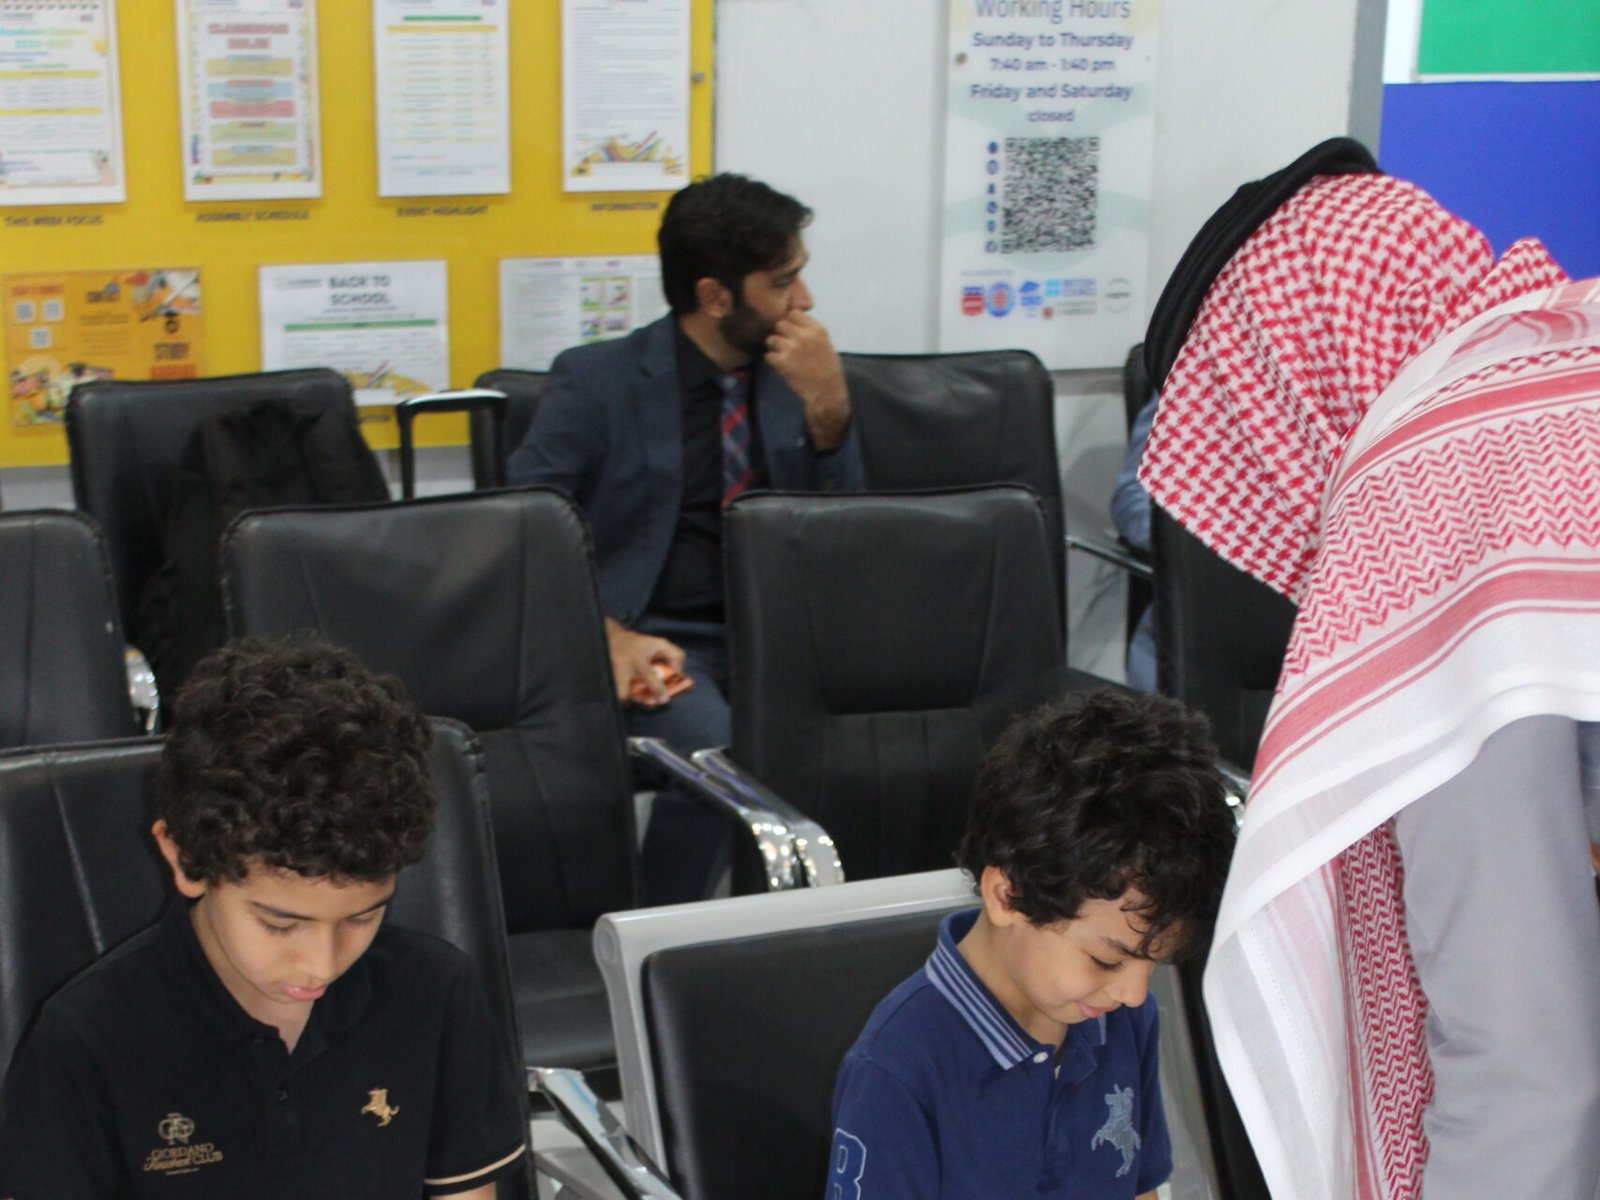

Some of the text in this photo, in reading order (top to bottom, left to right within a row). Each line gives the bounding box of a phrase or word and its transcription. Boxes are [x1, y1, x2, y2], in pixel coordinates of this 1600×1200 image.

[976, 0, 1131, 24] Working Hours
[972, 32, 1135, 50] Sunday to Thursday
[990, 58, 1022, 71] 7:40
[1025, 61, 1048, 71] am
[1060, 58, 1089, 71] 1:40
[1091, 61, 1115, 74] pm
[970, 84, 1133, 101] Friday and Saturday
[1028, 109, 1075, 122] closed
[255, 209, 309, 221] SCHEDULE
[328, 276, 368, 289] BACK
[371, 275, 391, 287] TO
[330, 292, 390, 306] SCHOOL
